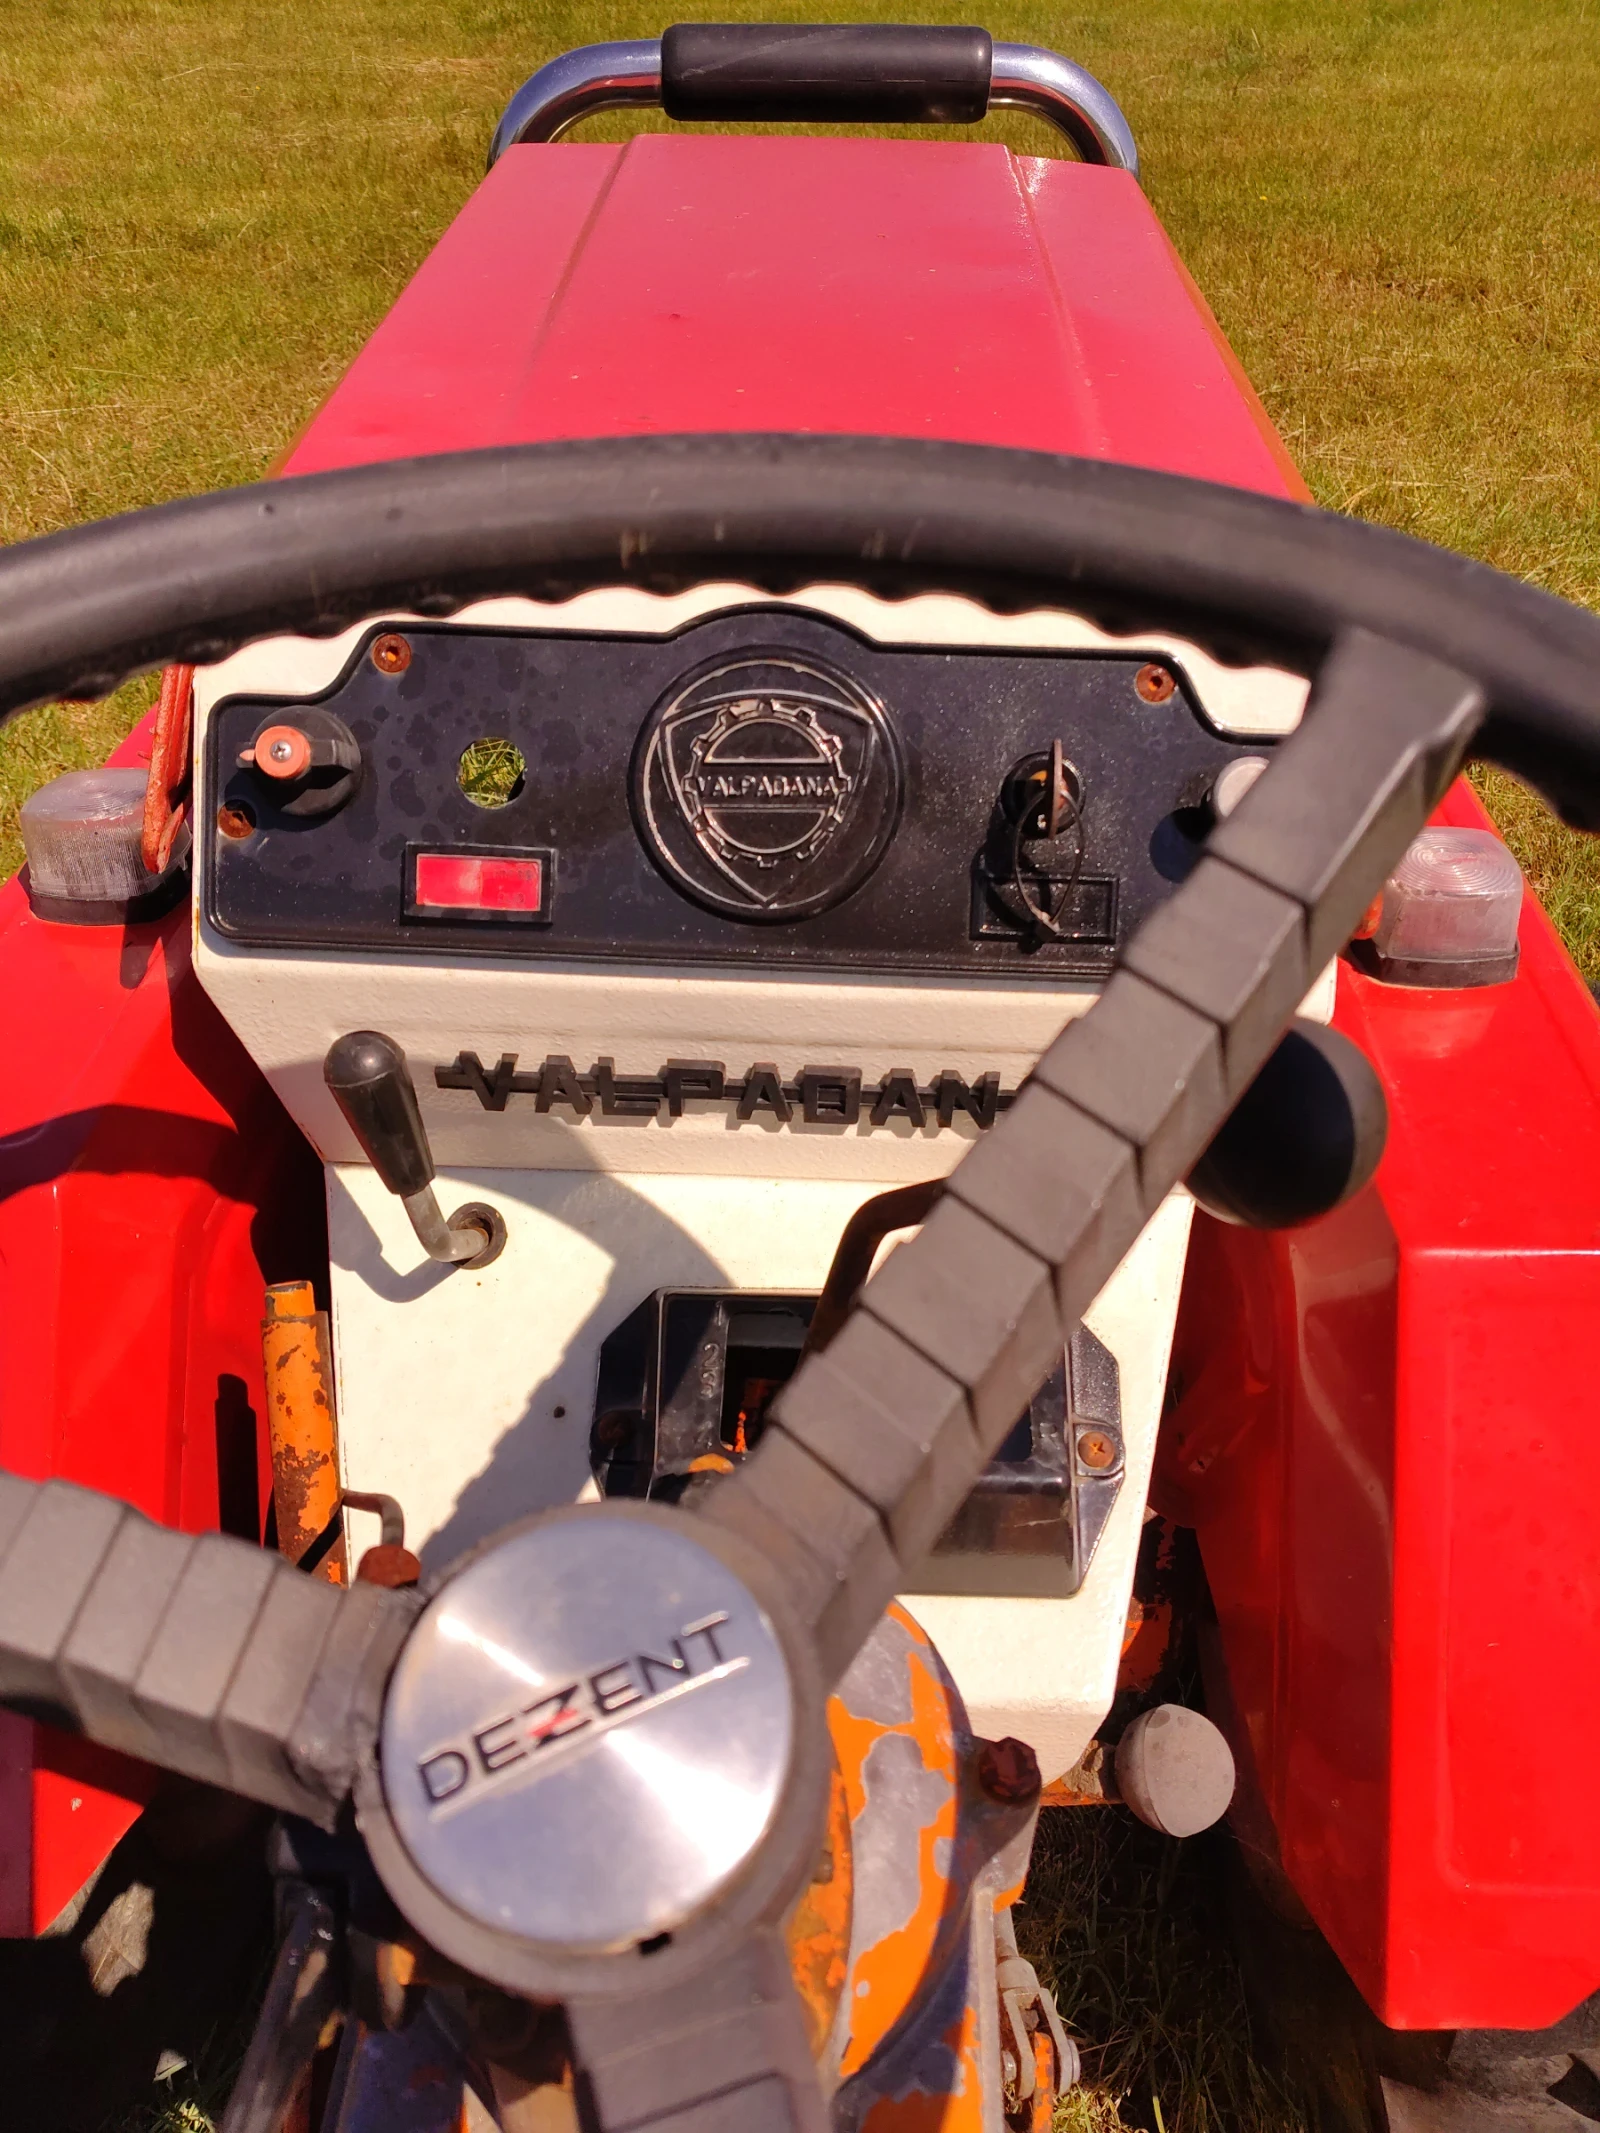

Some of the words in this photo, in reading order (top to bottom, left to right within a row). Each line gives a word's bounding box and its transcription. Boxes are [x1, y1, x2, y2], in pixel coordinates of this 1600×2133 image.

[697, 775, 838, 797] VALPADANA
[457, 1050, 1001, 1131] VALPADAN
[703, 1343, 720, 1369] 2
[416, 1610, 730, 1805] DEZENT
